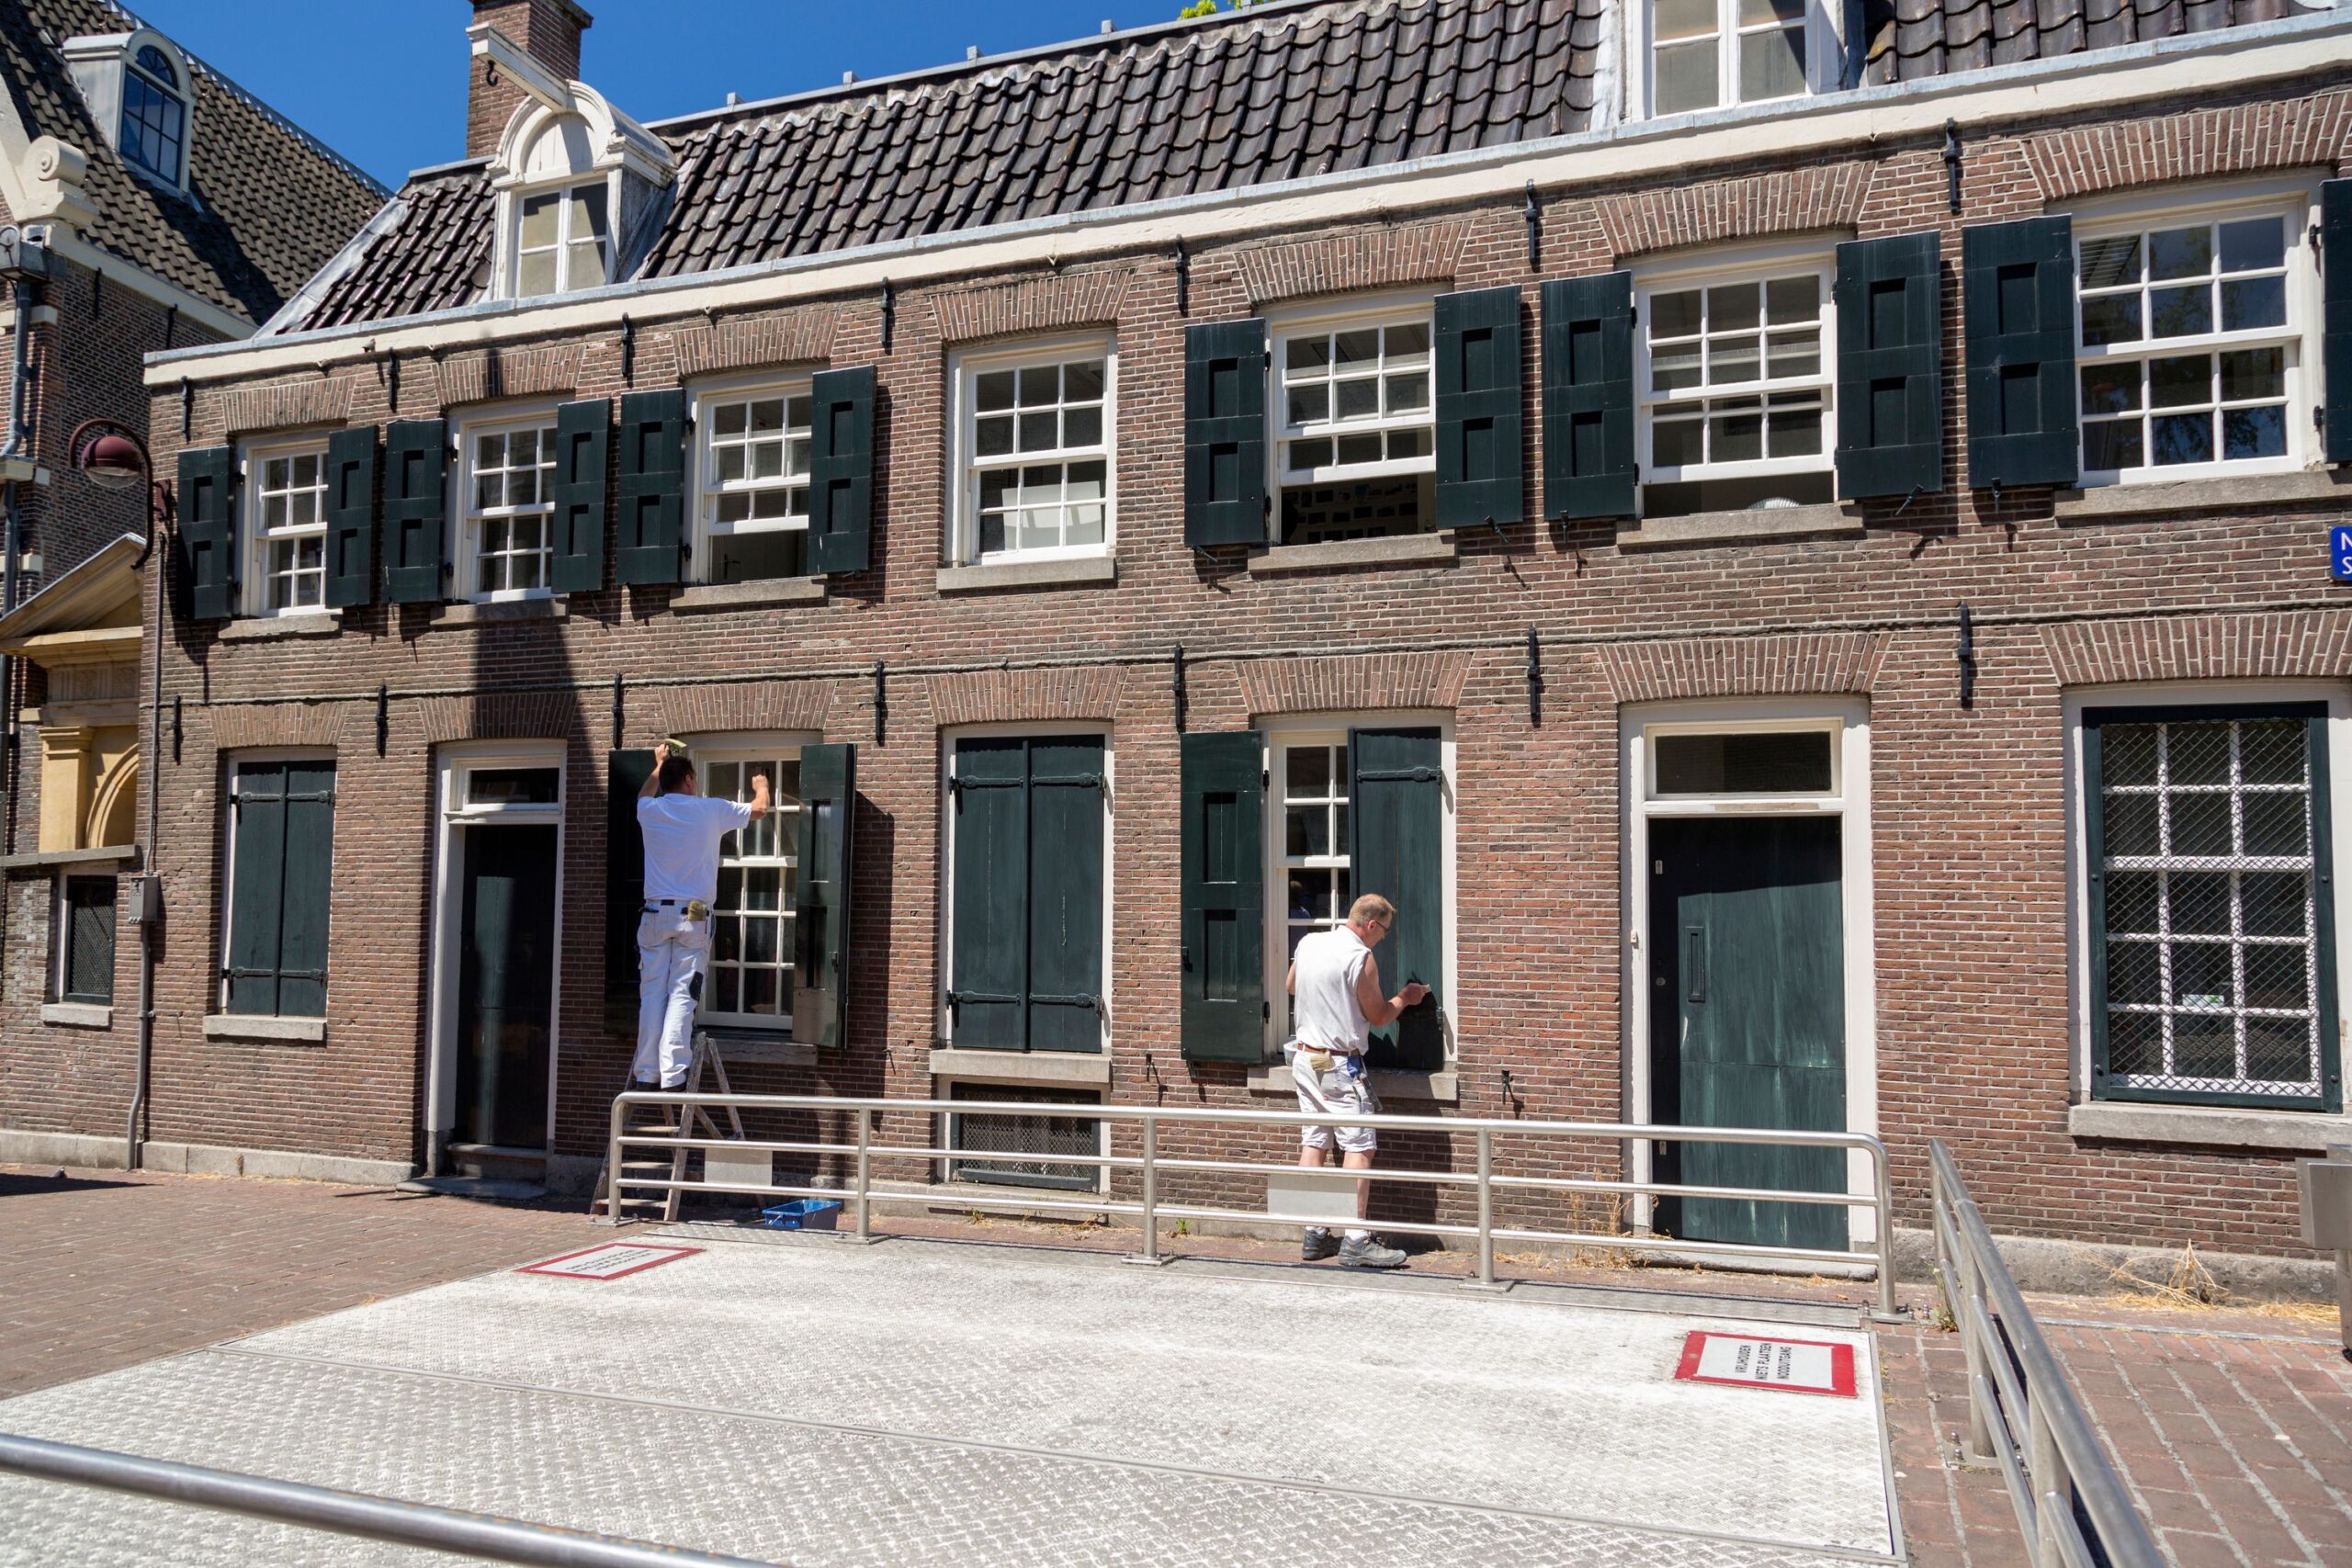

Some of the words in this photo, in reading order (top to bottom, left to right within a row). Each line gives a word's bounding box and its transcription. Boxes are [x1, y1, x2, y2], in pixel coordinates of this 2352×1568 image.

[1758, 1343, 1772, 1365] PLAATSEN
[1777, 1346, 1792, 1380] NOODUITGANG
[1756, 1366, 1770, 1380] NIETS
